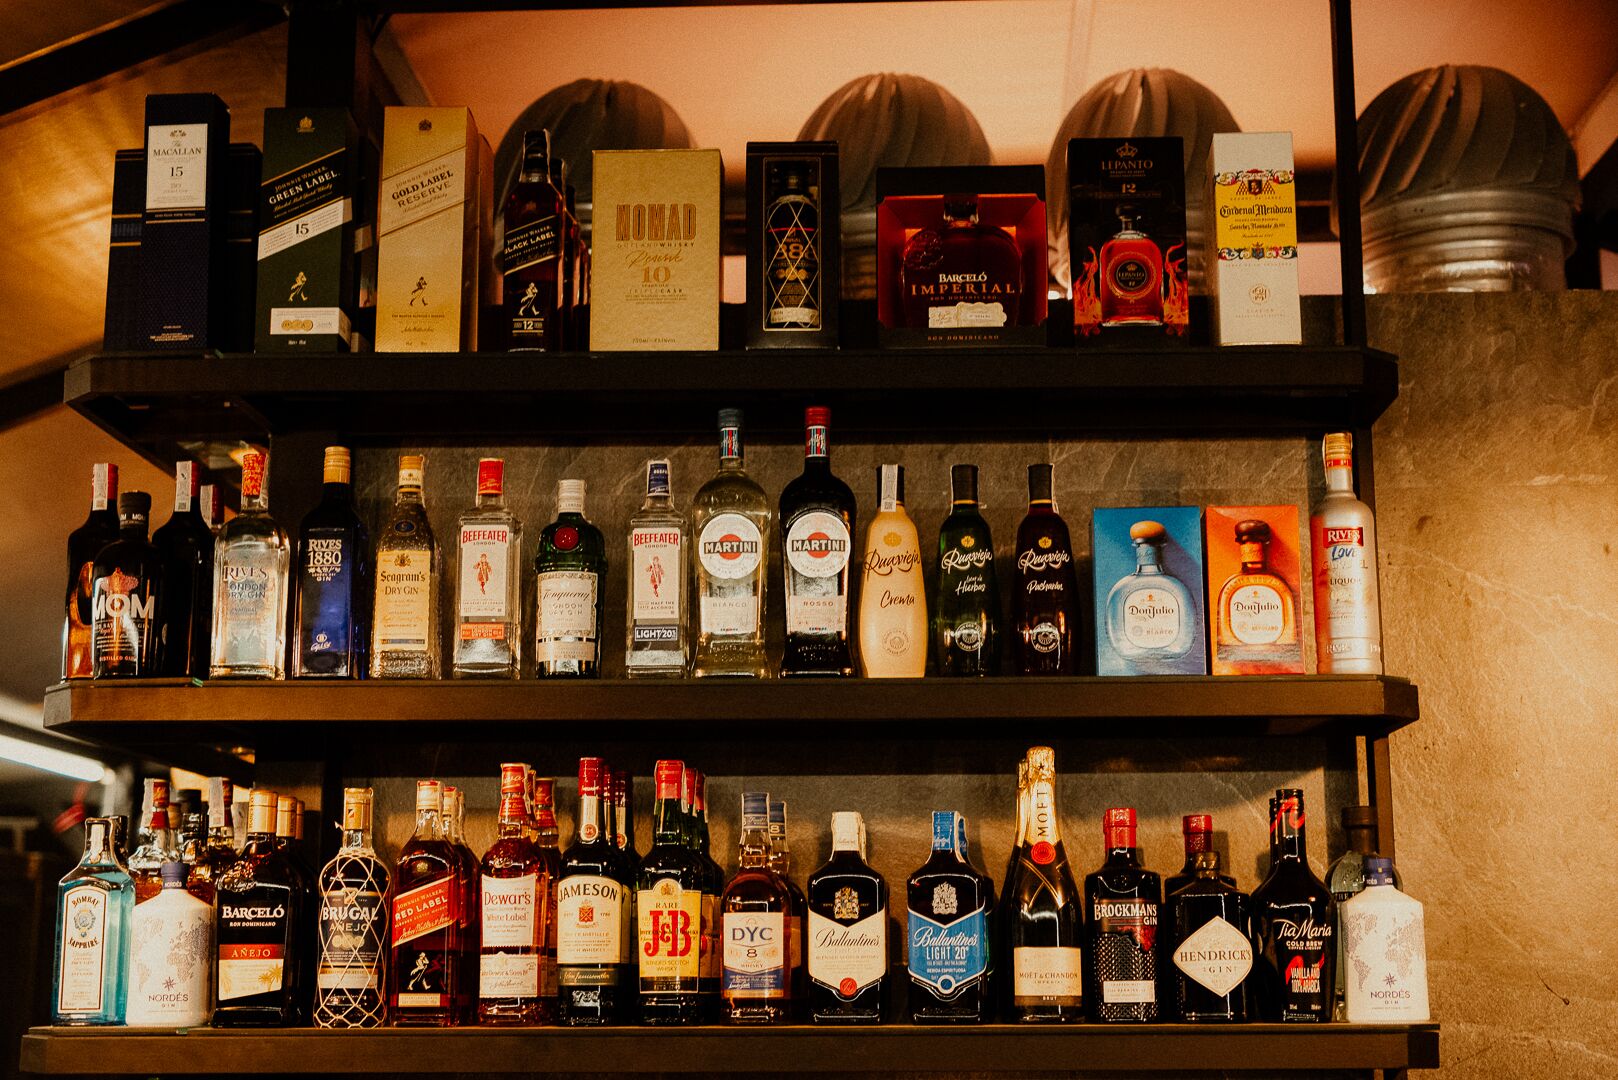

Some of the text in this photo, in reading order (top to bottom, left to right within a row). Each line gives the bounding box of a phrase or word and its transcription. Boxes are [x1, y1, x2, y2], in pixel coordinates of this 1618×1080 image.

[153, 147, 202, 156] MACALLAN
[170, 166, 184, 177] 15
[1101, 159, 1154, 171] LEPANTO
[268, 170, 338, 205] GREEN LABEL
[391, 169, 454, 201] GOLD LABEL
[1121, 183, 1137, 193] 12
[397, 181, 452, 208] RESERVE
[1220, 203, 1293, 218] Cardenal Mendoza
[615, 203, 697, 241] NOMAD
[294, 223, 310, 235] 15
[529, 230, 555, 245] LABEL
[641, 266, 671, 283] 10
[938, 272, 988, 283] BARCELÓ
[911, 283, 1015, 296] IMPERIAL
[523, 320, 534, 330] 12
[462, 530, 508, 543] BEEFEATER
[634, 533, 679, 546] BEEFEATER
[1328, 530, 1360, 542] RIVES
[308, 539, 342, 551] RIVES
[705, 542, 756, 553] MARTINI
[792, 540, 845, 551] MARTINI
[307, 551, 342, 567] 1880
[863, 549, 921, 581] Ruavieja
[941, 548, 992, 574] Ruavieja
[1018, 548, 1070, 575] Ruavieja
[223, 566, 269, 582] RIVES
[380, 571, 426, 584] Seagram's
[385, 585, 419, 595] DRY GIN
[955, 580, 986, 596] Hierbas
[543, 589, 591, 601] Tanqueray
[880, 590, 915, 608] Crema
[92, 593, 155, 620] MOM
[484, 891, 531, 905] Dewar's
[558, 883, 618, 903] JAMESON
[222, 904, 285, 920] BARCELÓ
[322, 906, 378, 921] BRUGAL
[394, 895, 448, 921] RED LABEL
[1094, 904, 1157, 921] BROCKMANS
[505, 912, 529, 921] Label
[1143, 916, 1158, 926] GIN
[329, 923, 369, 932] AÑEJO
[644, 910, 692, 957] J&B
[1273, 918, 1332, 940] Tia Maria
[732, 927, 773, 942] DYC
[815, 927, 880, 948] Ballantine's
[912, 926, 978, 947] Ballantine's
[68, 937, 100, 950] SAPPHIRE
[231, 948, 271, 958] AÑEJO
[746, 949, 758, 958] 8
[926, 947, 950, 960] LIGHT
[1180, 949, 1251, 962] HENDRICK'S
[1291, 967, 1320, 979] VANILLA AND
[149, 993, 188, 1002] NORDÉS
[1370, 989, 1411, 999] NORDÉS
